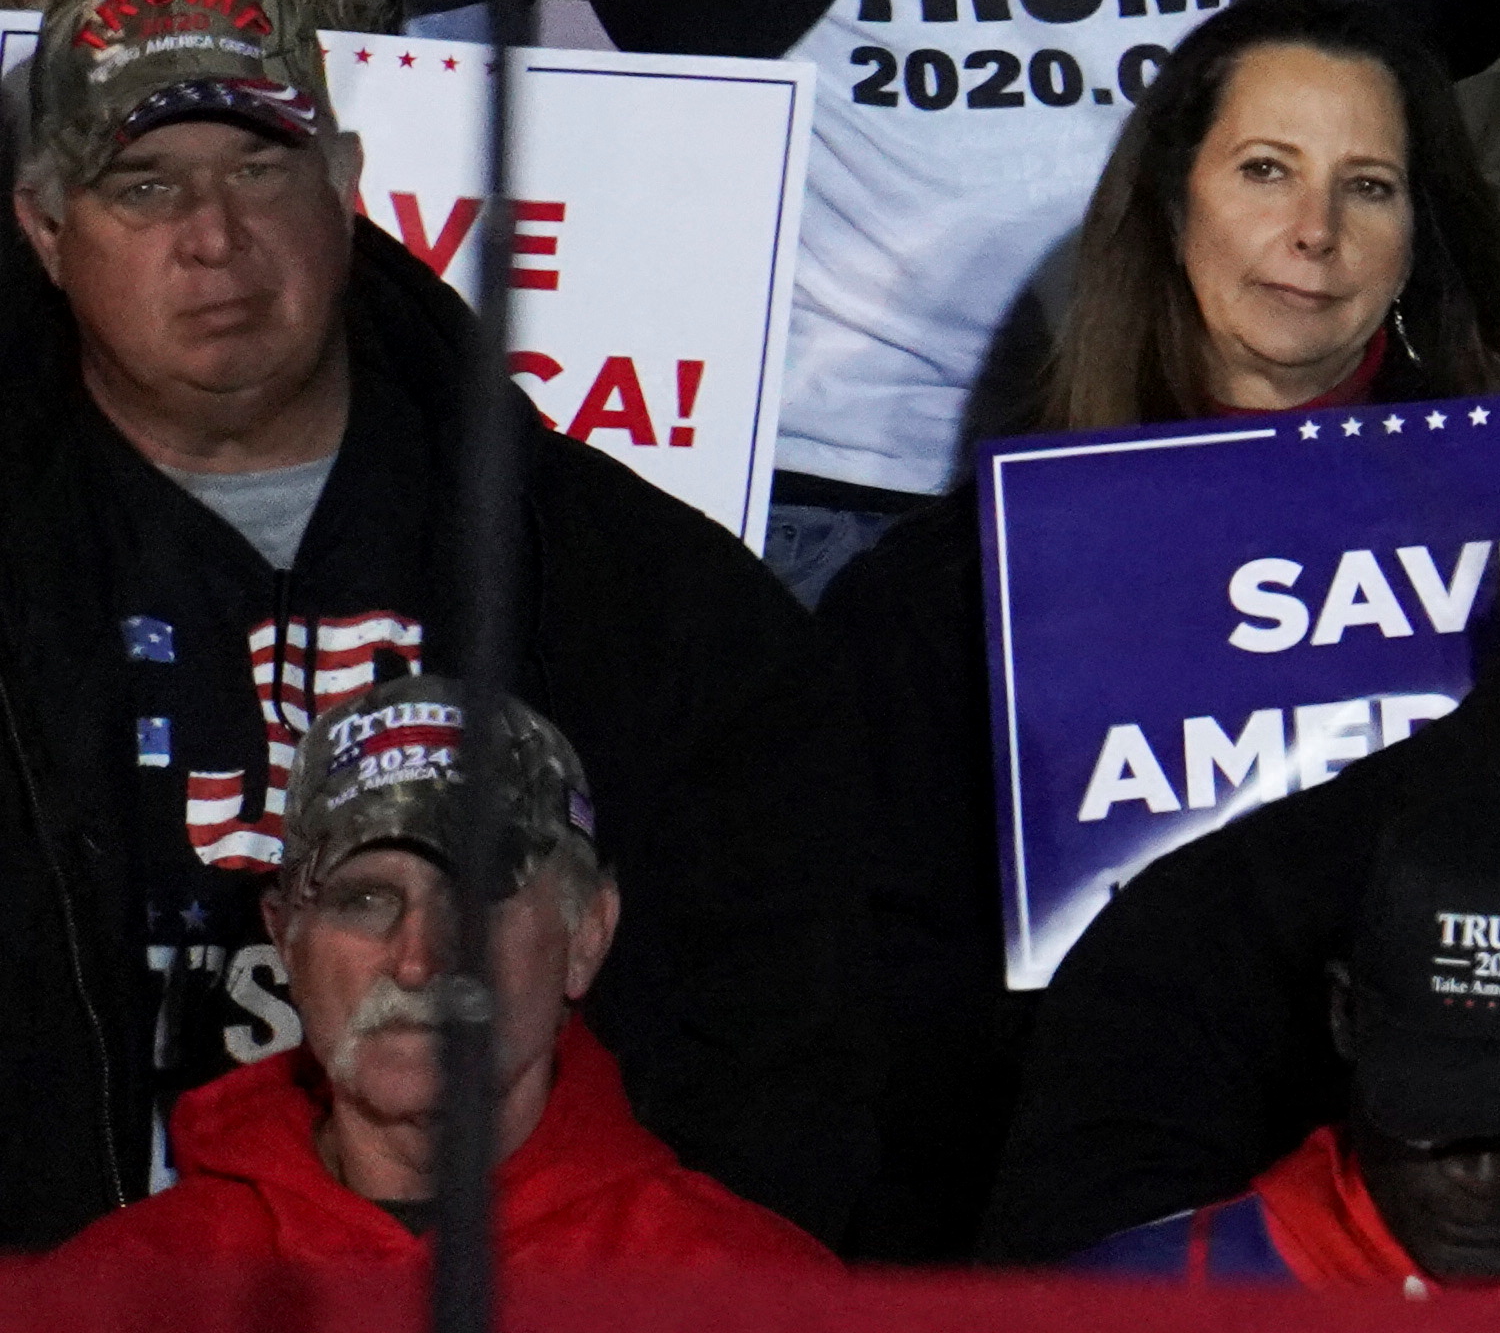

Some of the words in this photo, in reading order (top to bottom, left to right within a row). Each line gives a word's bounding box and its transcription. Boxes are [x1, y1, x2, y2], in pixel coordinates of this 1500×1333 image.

[146, 36, 215, 55] AMERICA
[329, 701, 463, 754] Trum
[359, 745, 453, 780] 2024
[1431, 975, 1468, 994] Take
